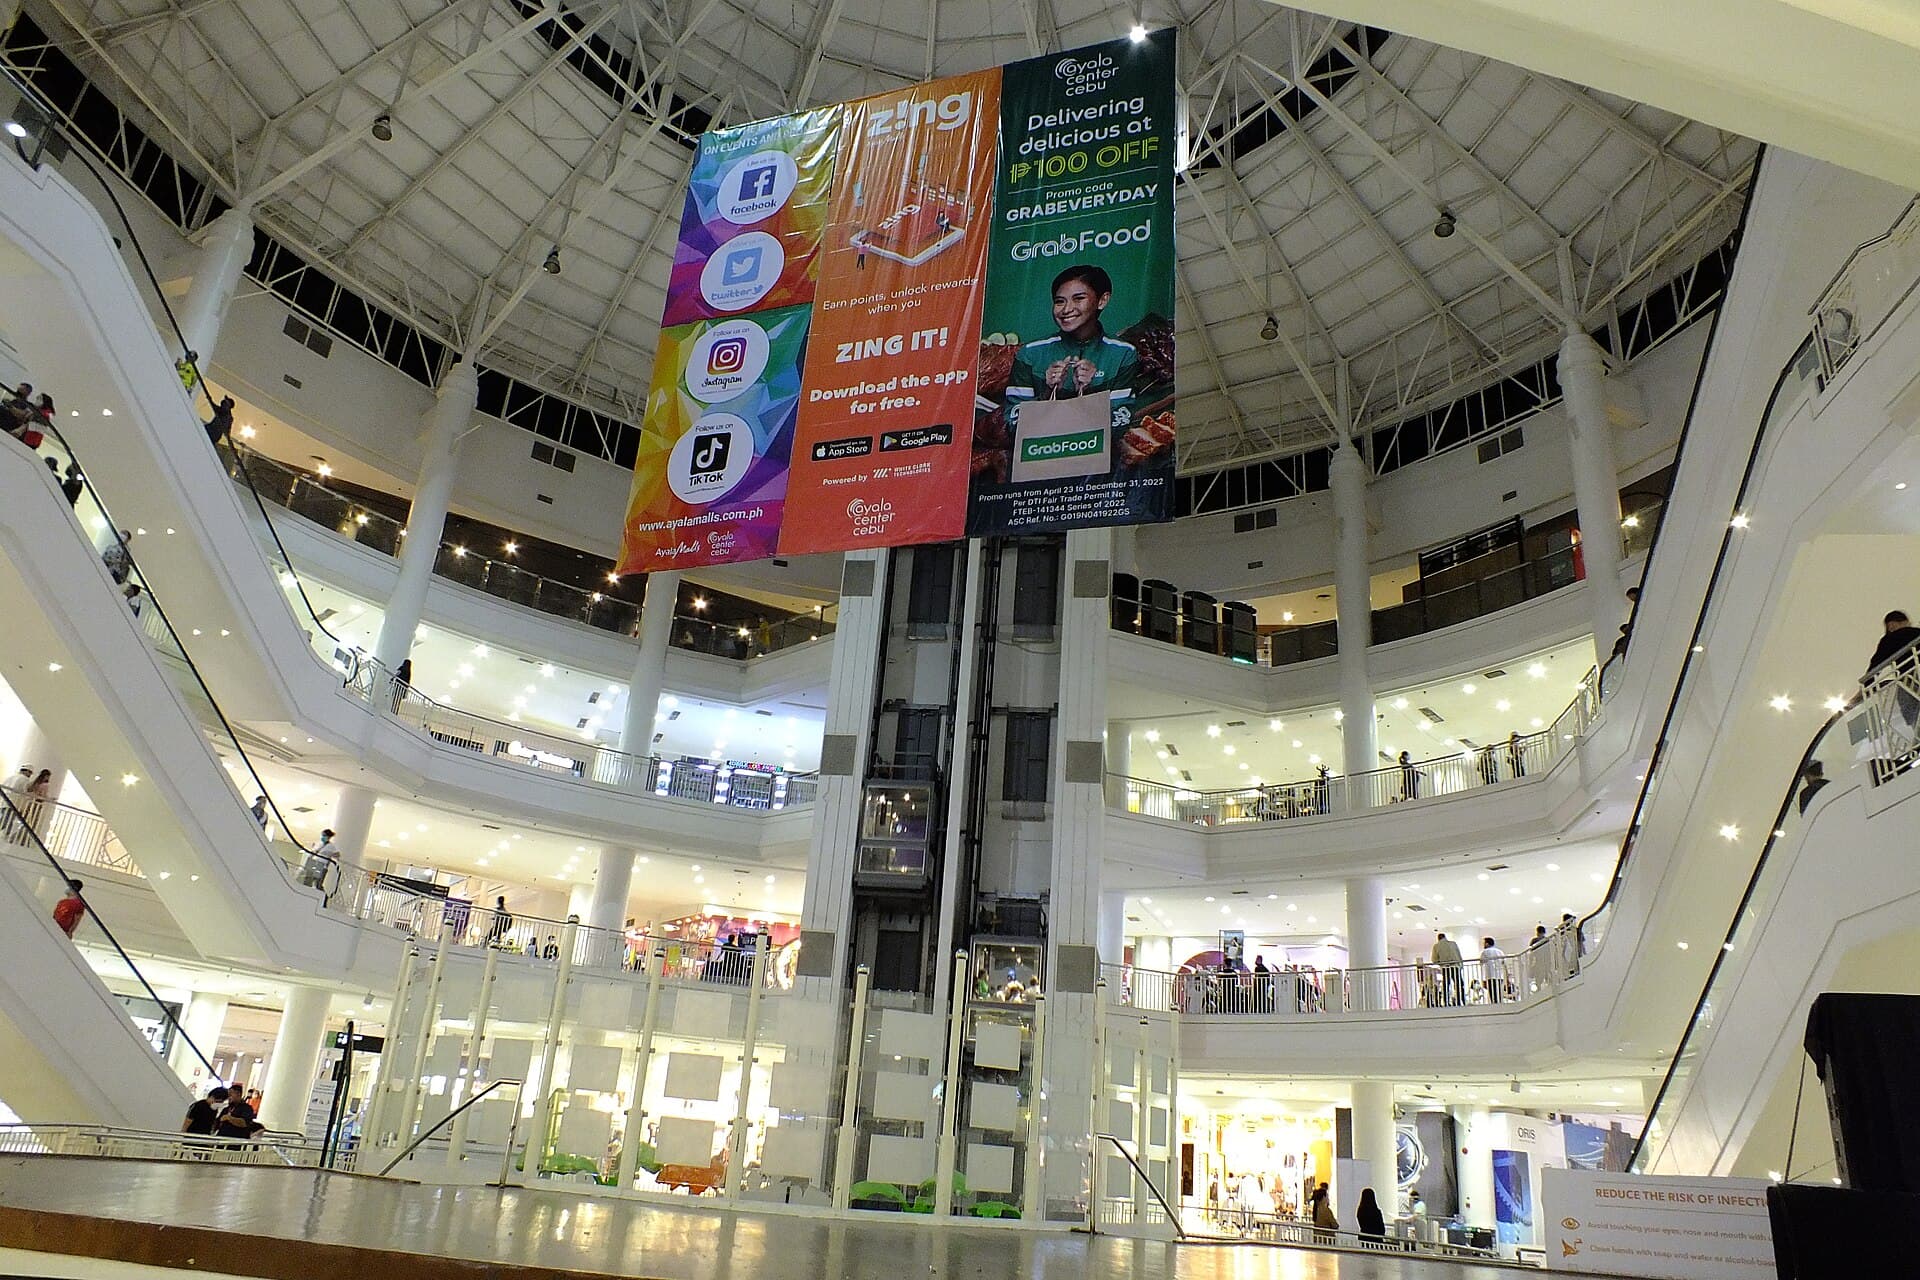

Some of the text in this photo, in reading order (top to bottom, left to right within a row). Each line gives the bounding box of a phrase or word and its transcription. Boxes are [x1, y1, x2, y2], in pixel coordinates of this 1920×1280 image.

[1059, 53, 1112, 76] ayala
[1066, 66, 1119, 86] center
[1065, 81, 1106, 97] cebu
[1028, 97, 1144, 131] Delivering
[1019, 116, 1152, 156] delicious at
[704, 144, 718, 155] ON
[720, 137, 758, 153] EVENTS
[1096, 136, 1159, 168] OFF
[1046, 182, 1113, 200] Promo code
[731, 199, 777, 215] facebook
[1006, 184, 1158, 222] GRABEVERYDAY
[1011, 219, 1151, 261] GrabFood
[711, 287, 753, 301] twitter
[823, 276, 979, 310] Earn points, unlock rewards
[868, 299, 921, 315] when you
[835, 327, 948, 363] ZING IT!
[701, 376, 742, 389] Instagram
[810, 369, 968, 402] Download the app
[850, 396, 921, 414] for free.
[695, 424, 715, 432] Follow
[901, 433, 948, 447] Google Play
[1028, 436, 1097, 456] GrabFood
[828, 445, 868, 457] App Store
[822, 474, 868, 486] Powered by
[979, 494, 1003, 502] Promo
[1005, 491, 1022, 499] runs
[1043, 487, 1061, 496] April
[1063, 486, 1074, 494] 23
[1085, 481, 1127, 491] December
[1129, 479, 1141, 487] 31,
[1143, 478, 1164, 486] 2022
[1027, 498, 1041, 506] DTI
[1060, 494, 1082, 503] Trade
[1084, 491, 1110, 500] Permit
[1112, 490, 1126, 498] No.
[850, 498, 891, 516] ayala
[1067, 503, 1092, 511] Series
[1104, 499, 1125, 508] 2022
[639, 507, 763, 532] www.ayalamalls.com.ph
[854, 513, 895, 525] center
[1008, 517, 1024, 526] ASC
[1026, 516, 1040, 524] Ref.
[853, 525, 884, 536] cebu
[710, 548, 729, 556] cebu
[711, 540, 736, 549] center
[1518, 1127, 1536, 1139] ORIS
[1595, 1188, 1768, 1208] REDUCE THE RISK OF INFECTI
[1721, 1231, 1748, 1240] mouth
